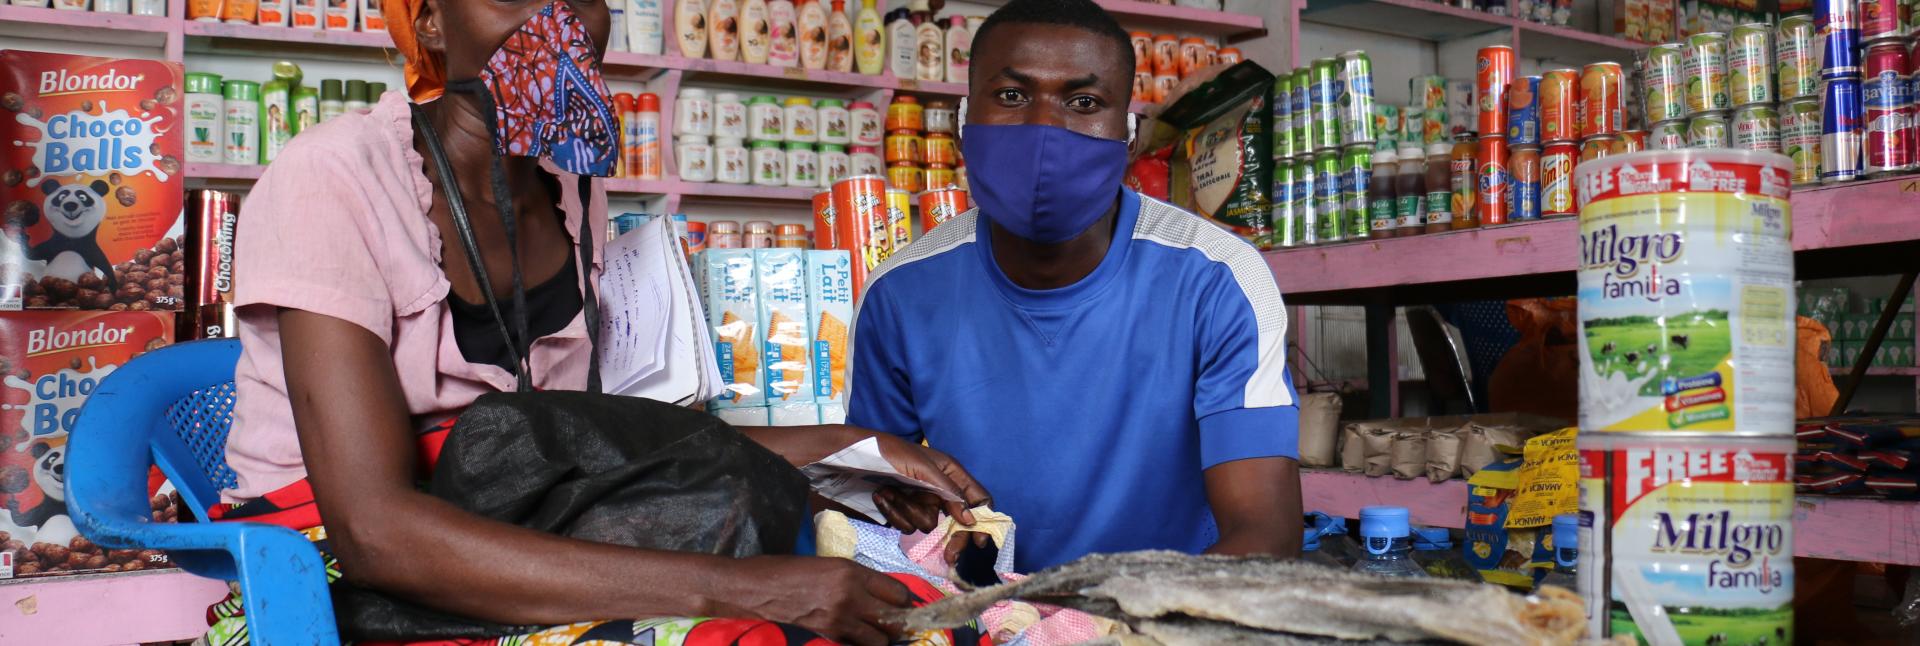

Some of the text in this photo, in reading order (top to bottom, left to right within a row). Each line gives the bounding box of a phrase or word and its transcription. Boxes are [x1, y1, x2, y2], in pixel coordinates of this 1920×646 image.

[39, 69, 145, 94] Blondor
[47, 114, 143, 140] Choco
[44, 138, 142, 173] Balls
[1579, 168, 1614, 208] REE
[1713, 178, 1747, 194] FREE
[1580, 224, 1682, 276] Milgro
[821, 263, 837, 304] Lait
[837, 270, 849, 304] Petit
[1603, 264, 1681, 301] familia
[27, 322, 135, 354] Blondor
[36, 373, 104, 401] Cho
[1626, 448, 1729, 505] FREE
[1652, 511, 1783, 566] Milgro
[1708, 556, 1783, 594] familia
